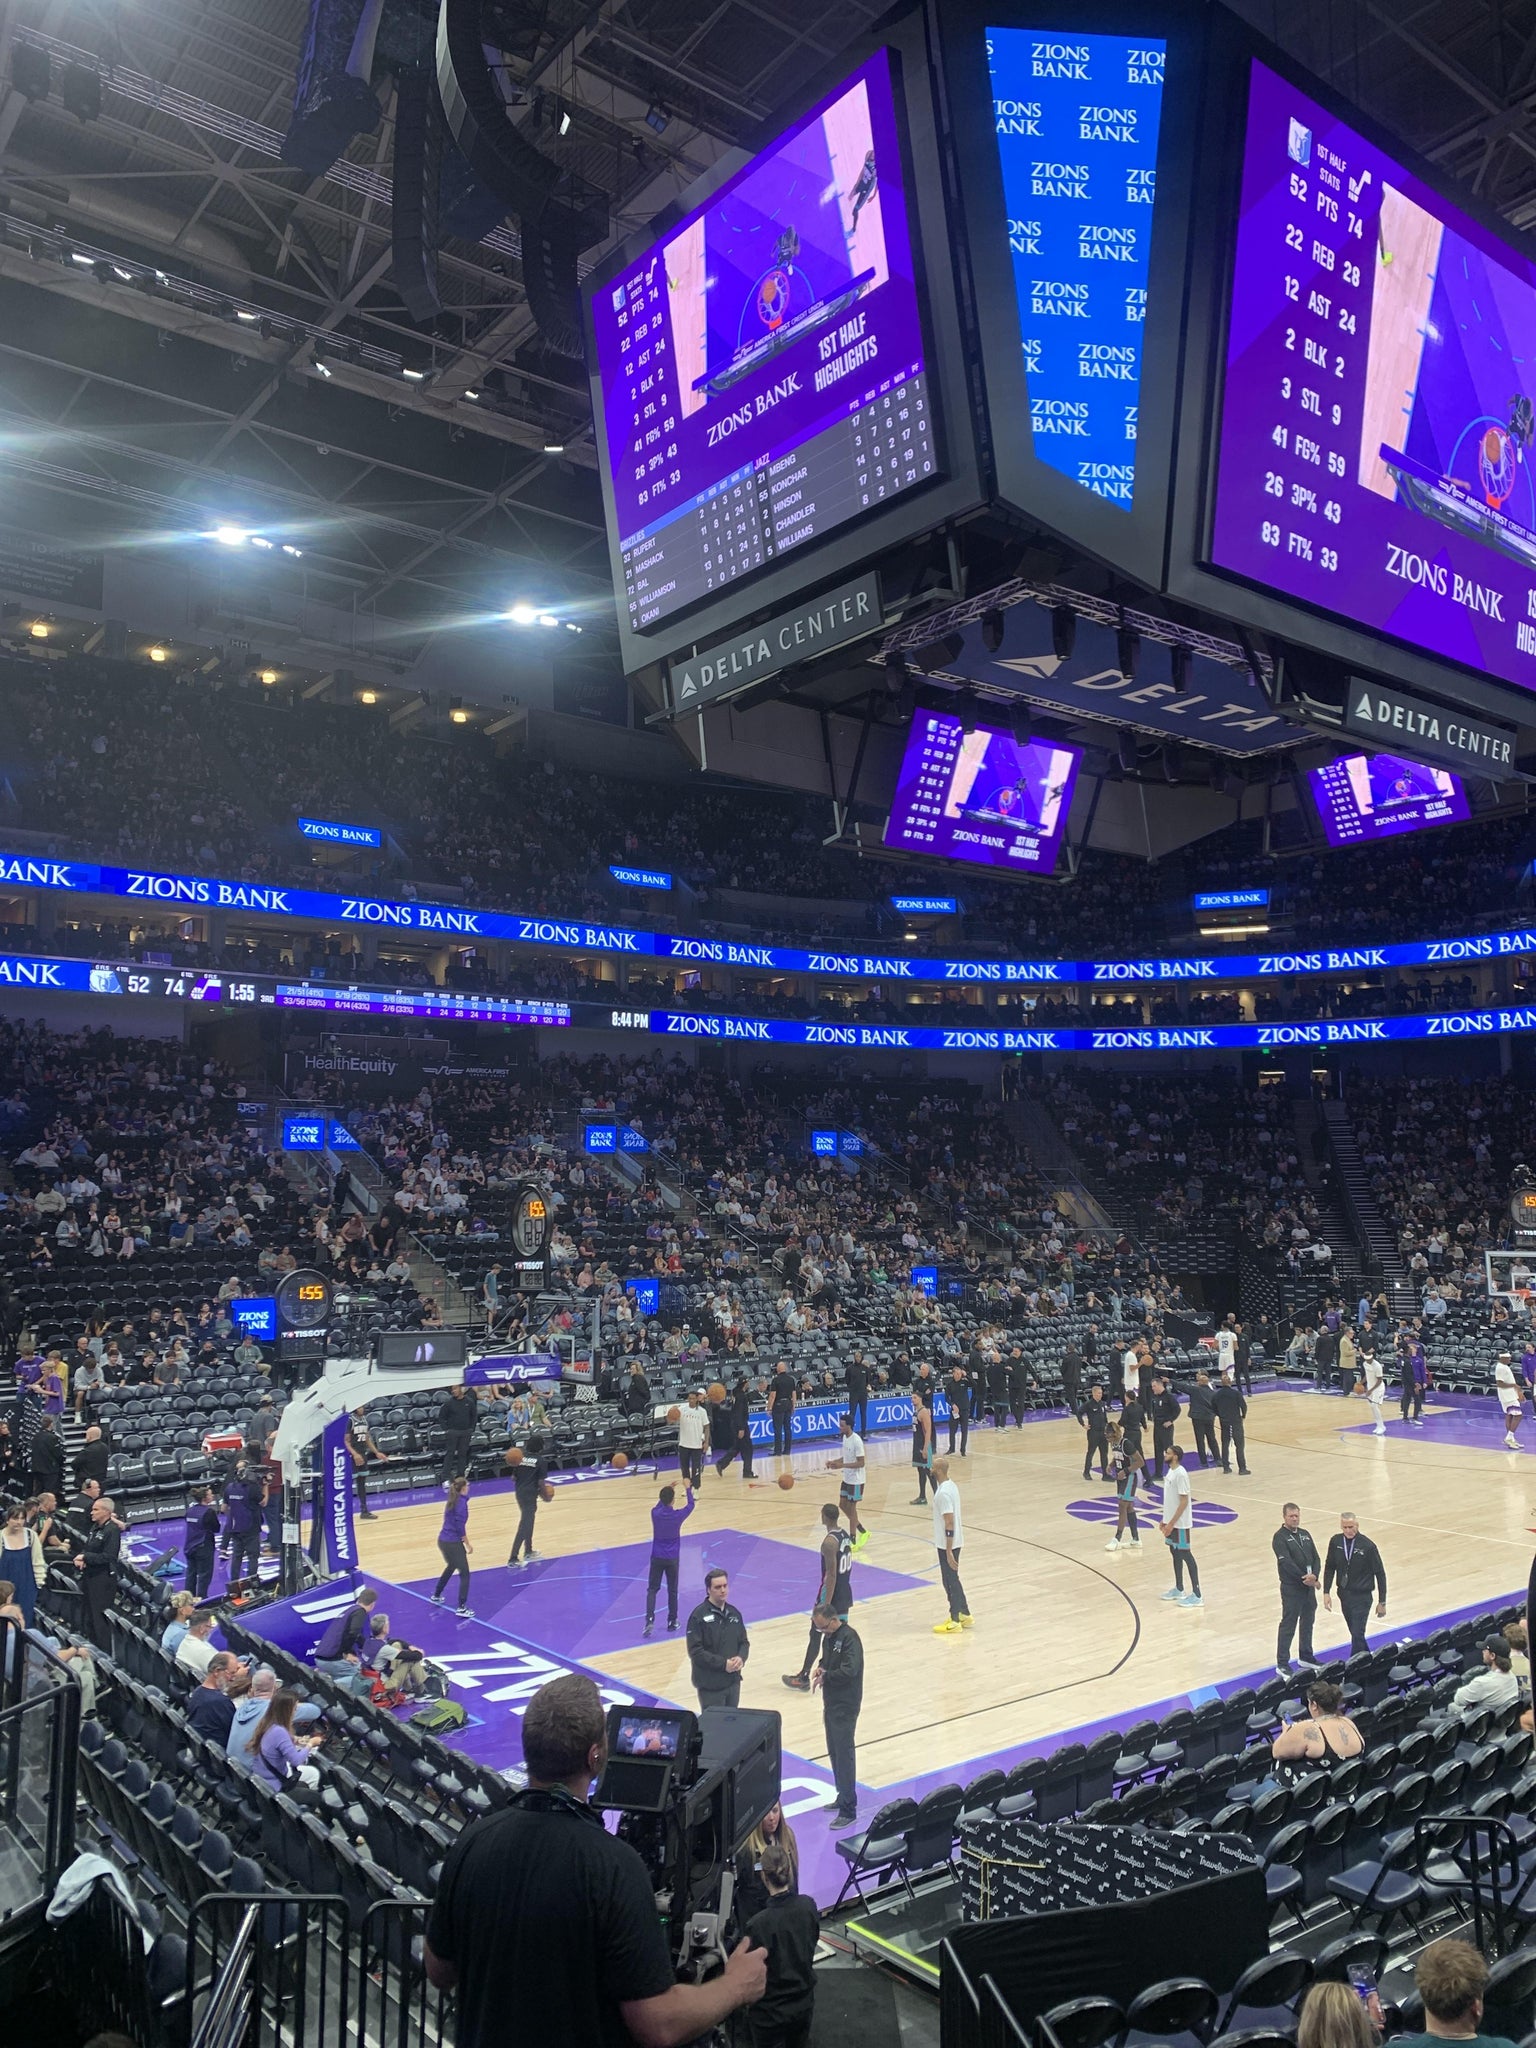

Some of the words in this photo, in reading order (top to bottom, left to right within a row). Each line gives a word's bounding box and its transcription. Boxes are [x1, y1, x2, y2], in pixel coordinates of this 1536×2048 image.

[1031, 43, 1090, 62] ZIONS
[1031, 61, 1092, 80] BANK
[1079, 106, 1137, 124] ZIONS
[1079, 124, 1139, 143] BANK
[1031, 162, 1090, 180] ZIONS
[1330, 152, 1347, 173] HALF
[1031, 180, 1092, 199] BANK
[1320, 167, 1341, 191] STATS
[1290, 173, 1308, 202] 52
[1317, 192, 1338, 222] PTS
[1348, 212, 1363, 240] 74
[1078, 225, 1136, 244] ZIONS
[1078, 243, 1138, 263] BANK
[1285, 224, 1304, 252] 22
[1312, 240, 1336, 272] REB
[1343, 260, 1360, 288] 28
[617, 311, 628, 328] 52
[632, 298, 644, 316] PTS
[648, 286, 658, 302] 74
[1284, 275, 1300, 302] 12
[1308, 290, 1332, 320] AST
[1339, 308, 1356, 336] 24
[621, 337, 631, 353] 22
[634, 324, 648, 342] REB
[652, 312, 662, 328] 28
[754, 331, 776, 348] AMERICA
[776, 321, 791, 336] FIRST
[818, 331, 837, 362] 1ST
[839, 312, 866, 348] HALF
[625, 362, 634, 376] 12
[638, 348, 651, 368] AST
[655, 338, 666, 355] 24
[814, 334, 878, 392] HIGHLIGHTS
[1078, 343, 1136, 362] ZIONS
[1304, 338, 1328, 368] BLK
[1078, 361, 1138, 381] BANK
[706, 402, 752, 448] ZIONS
[754, 371, 803, 416] BANK
[1301, 387, 1322, 416] STL
[634, 438, 642, 452] 41
[645, 426, 660, 446] FG%
[664, 416, 675, 433] 59
[635, 464, 646, 480] 26
[648, 452, 664, 471] 3P%
[667, 443, 678, 458] 43
[754, 452, 770, 471] JAZZ
[1272, 424, 1288, 450] 41
[1295, 434, 1321, 466] FG%
[1328, 451, 1346, 478] 59
[769, 454, 796, 477] MBENG
[1078, 462, 1134, 480] ZIONS
[638, 490, 648, 506] 83
[652, 478, 666, 497] FT%
[670, 470, 680, 486] 33
[771, 466, 808, 495] KONCHAR
[773, 490, 802, 514] HINSON
[1265, 471, 1284, 498] 26
[1291, 483, 1317, 514] 3P%
[1324, 500, 1342, 525] 43
[776, 502, 816, 532] CHANDLER
[1465, 495, 1491, 518] AMERICA
[1491, 505, 1508, 528] FIRST
[633, 537, 656, 558] RUPERT
[778, 524, 814, 550] WILLIAMS
[1261, 520, 1280, 547] 83
[1288, 532, 1312, 562] FT%
[1320, 547, 1338, 572] 33
[635, 550, 664, 574] MASHACK
[637, 578, 650, 591] BAL
[1385, 542, 1448, 596] ZIONS
[1452, 573, 1505, 622] BANK
[639, 580, 676, 608] WILLIAMSON
[641, 606, 660, 623] OKANI
[700, 638, 772, 688] DELTA
[778, 591, 870, 650] CENTER
[1072, 668, 1281, 732] DELTA
[1378, 700, 1440, 741] DELTA
[1446, 724, 1511, 764] CENTER
[1374, 815, 1398, 827] ZIONS
[1397, 810, 1420, 822] BANK
[304, 822, 339, 838] ZIONS
[342, 828, 374, 843] BANK
[952, 830, 980, 844] ZIONS
[980, 834, 1006, 848] BANK
[613, 870, 640, 883] ZIONS
[642, 874, 667, 886] BANK
[126, 873, 209, 903] ZIONS
[218, 884, 293, 912] BANK
[1200, 894, 1232, 906] ZIONS
[1233, 893, 1262, 904] BANK
[896, 900, 923, 910] ZIONS
[925, 900, 951, 910] BANK
[341, 899, 412, 926] ZIONS
[418, 909, 482, 934] BANK
[519, 920, 579, 946] ZIONS
[584, 930, 640, 951] BANK
[671, 938, 723, 961] ZIONS
[728, 946, 776, 966] BANK
[1426, 938, 1493, 961] ZIONS
[808, 954, 860, 974] ZIONS
[864, 958, 914, 976] BANK
[946, 962, 1000, 980] ZIONS
[1006, 964, 1061, 980] BANK
[1093, 963, 1154, 980] ZIONS
[1160, 960, 1218, 977] BANK
[1258, 954, 1322, 974] ZIONS
[1328, 949, 1390, 969] BANK
[128, 976, 150, 994] 52
[163, 978, 185, 996] 74
[228, 983, 255, 1002] 1:55
[260, 994, 275, 1004] 3RD
[284, 996, 306, 1006] 33/56
[612, 1012, 634, 1027] 8:44
[634, 1013, 648, 1029] PM
[666, 1014, 720, 1036] ZIONS
[725, 1019, 773, 1040] BANK
[1426, 1015, 1493, 1036] ZIONS
[805, 1026, 856, 1044] ZIONS
[861, 1030, 912, 1046] BANK
[944, 1032, 999, 1048] ZIONS
[1004, 1033, 1060, 1049] BANK
[1092, 1032, 1152, 1048] ZIONS
[1158, 1030, 1218, 1047] BANK
[1258, 1026, 1322, 1044] ZIONS
[1327, 1022, 1390, 1041] BANK
[304, 1056, 396, 1076] HealthEquity
[290, 1126, 318, 1134] ZIONS
[290, 1134, 319, 1143] BANK
[239, 1312, 269, 1322] ZIONS
[295, 1329, 327, 1338] TISSOT
[334, 1446, 346, 1488] FIRST
[333, 1489, 350, 1560] AMERICA
[839, 1552, 852, 1574] 00
[1055, 1826, 1086, 1846] Travelpass
[1001, 1839, 1030, 1859] Travelpass
[1218, 1842, 1257, 1864] Travelpass
[1073, 1852, 1104, 1872] Travelpass
[1154, 1856, 1189, 1879] Travelpass
[1057, 1864, 1088, 1884] Travelpass
